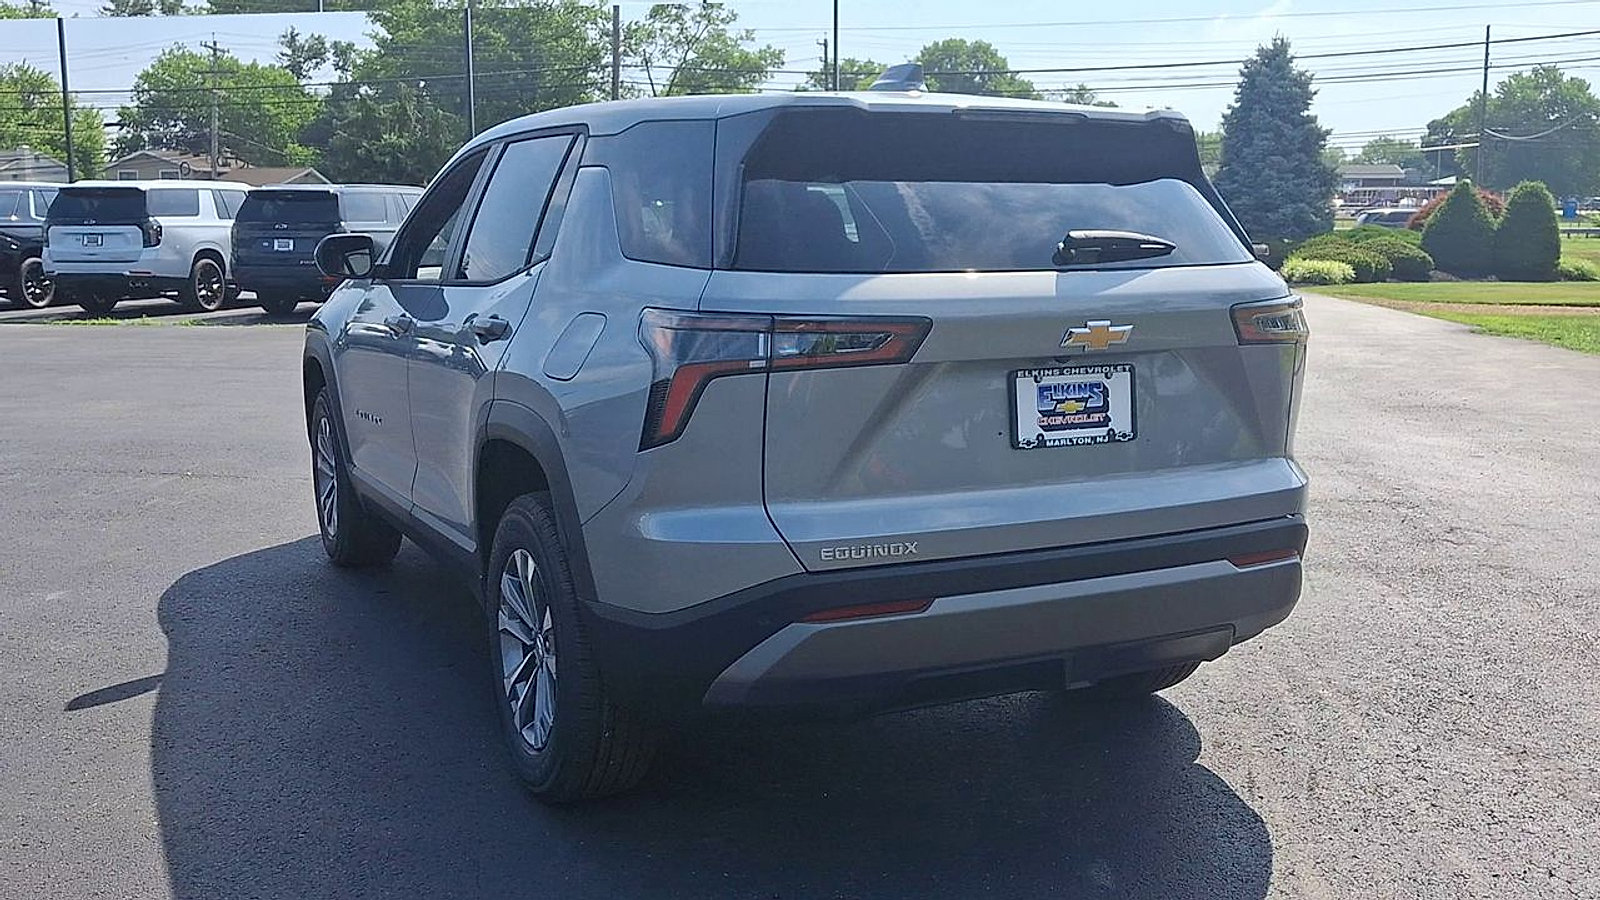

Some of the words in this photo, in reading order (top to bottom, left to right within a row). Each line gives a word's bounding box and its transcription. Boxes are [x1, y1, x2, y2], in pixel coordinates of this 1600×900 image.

[1017, 370, 1060, 378] ELKINS
[1064, 365, 1131, 375] CHEVROLET
[1037, 382, 1104, 410] ELKINS
[1037, 413, 1105, 426] CHEVROLET
[1096, 435, 1109, 444] NJ
[821, 541, 918, 560] EQUINOX
